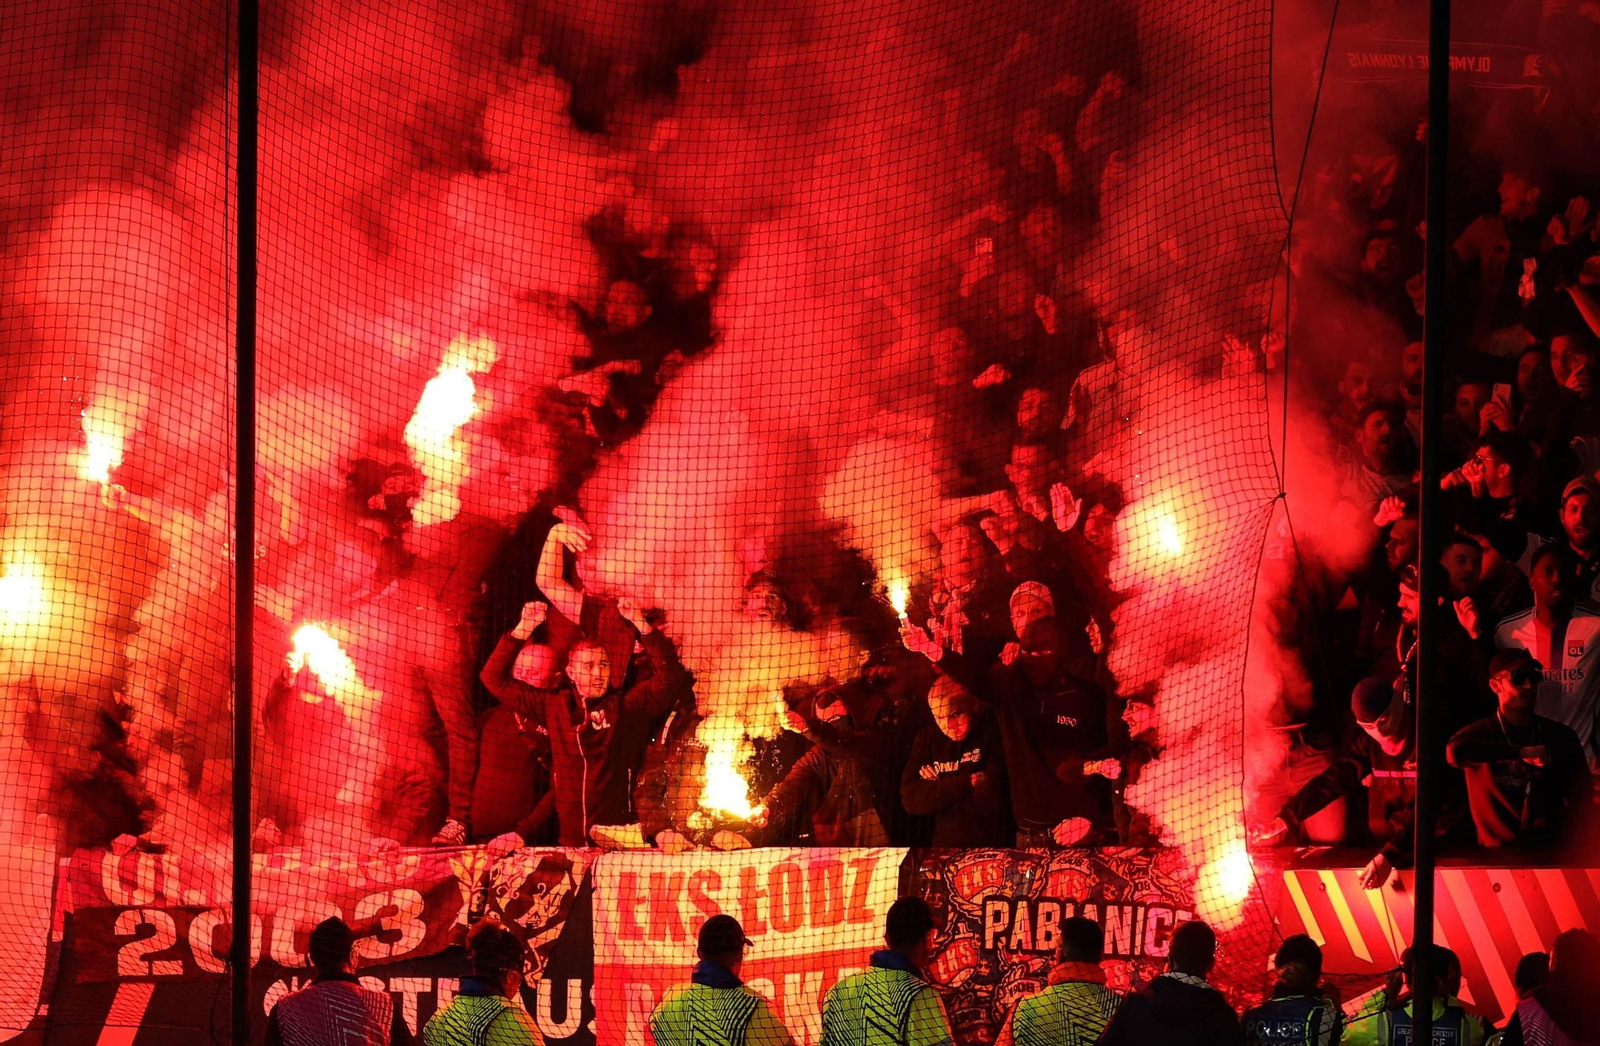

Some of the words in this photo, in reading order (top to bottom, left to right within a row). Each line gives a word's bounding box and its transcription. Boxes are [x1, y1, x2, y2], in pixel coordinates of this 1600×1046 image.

[1569, 646, 1582, 656] OL
[1543, 666, 1584, 682] irates
[114, 888, 427, 977] 2003
[1246, 1020, 1302, 1038] POLICE
[1405, 1036, 1446, 1046] PCE
